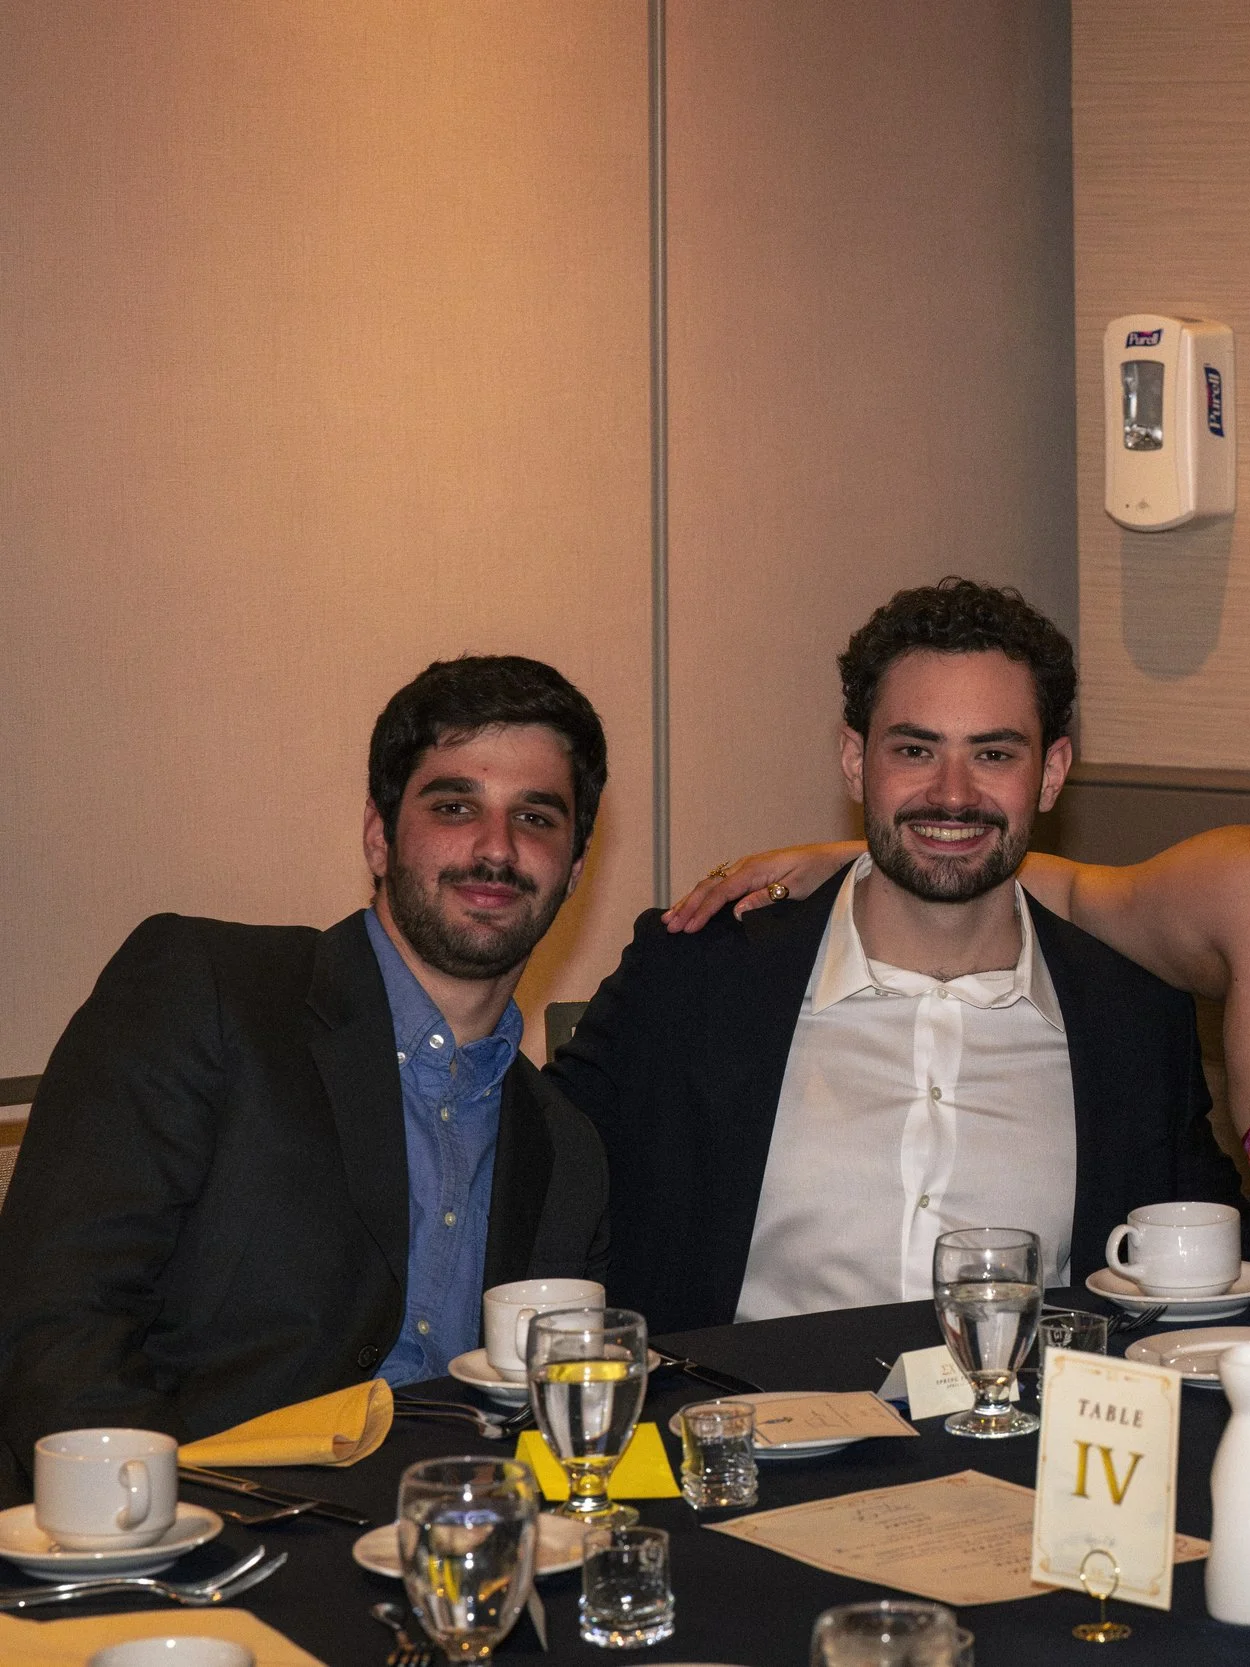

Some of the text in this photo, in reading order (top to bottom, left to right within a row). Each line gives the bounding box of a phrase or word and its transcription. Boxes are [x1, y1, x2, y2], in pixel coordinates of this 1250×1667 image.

[1128, 332, 1159, 346] Purell
[1209, 372, 1220, 429] Purell
[1078, 1399, 1144, 1429] TABLE
[1071, 1439, 1145, 1506] IV
